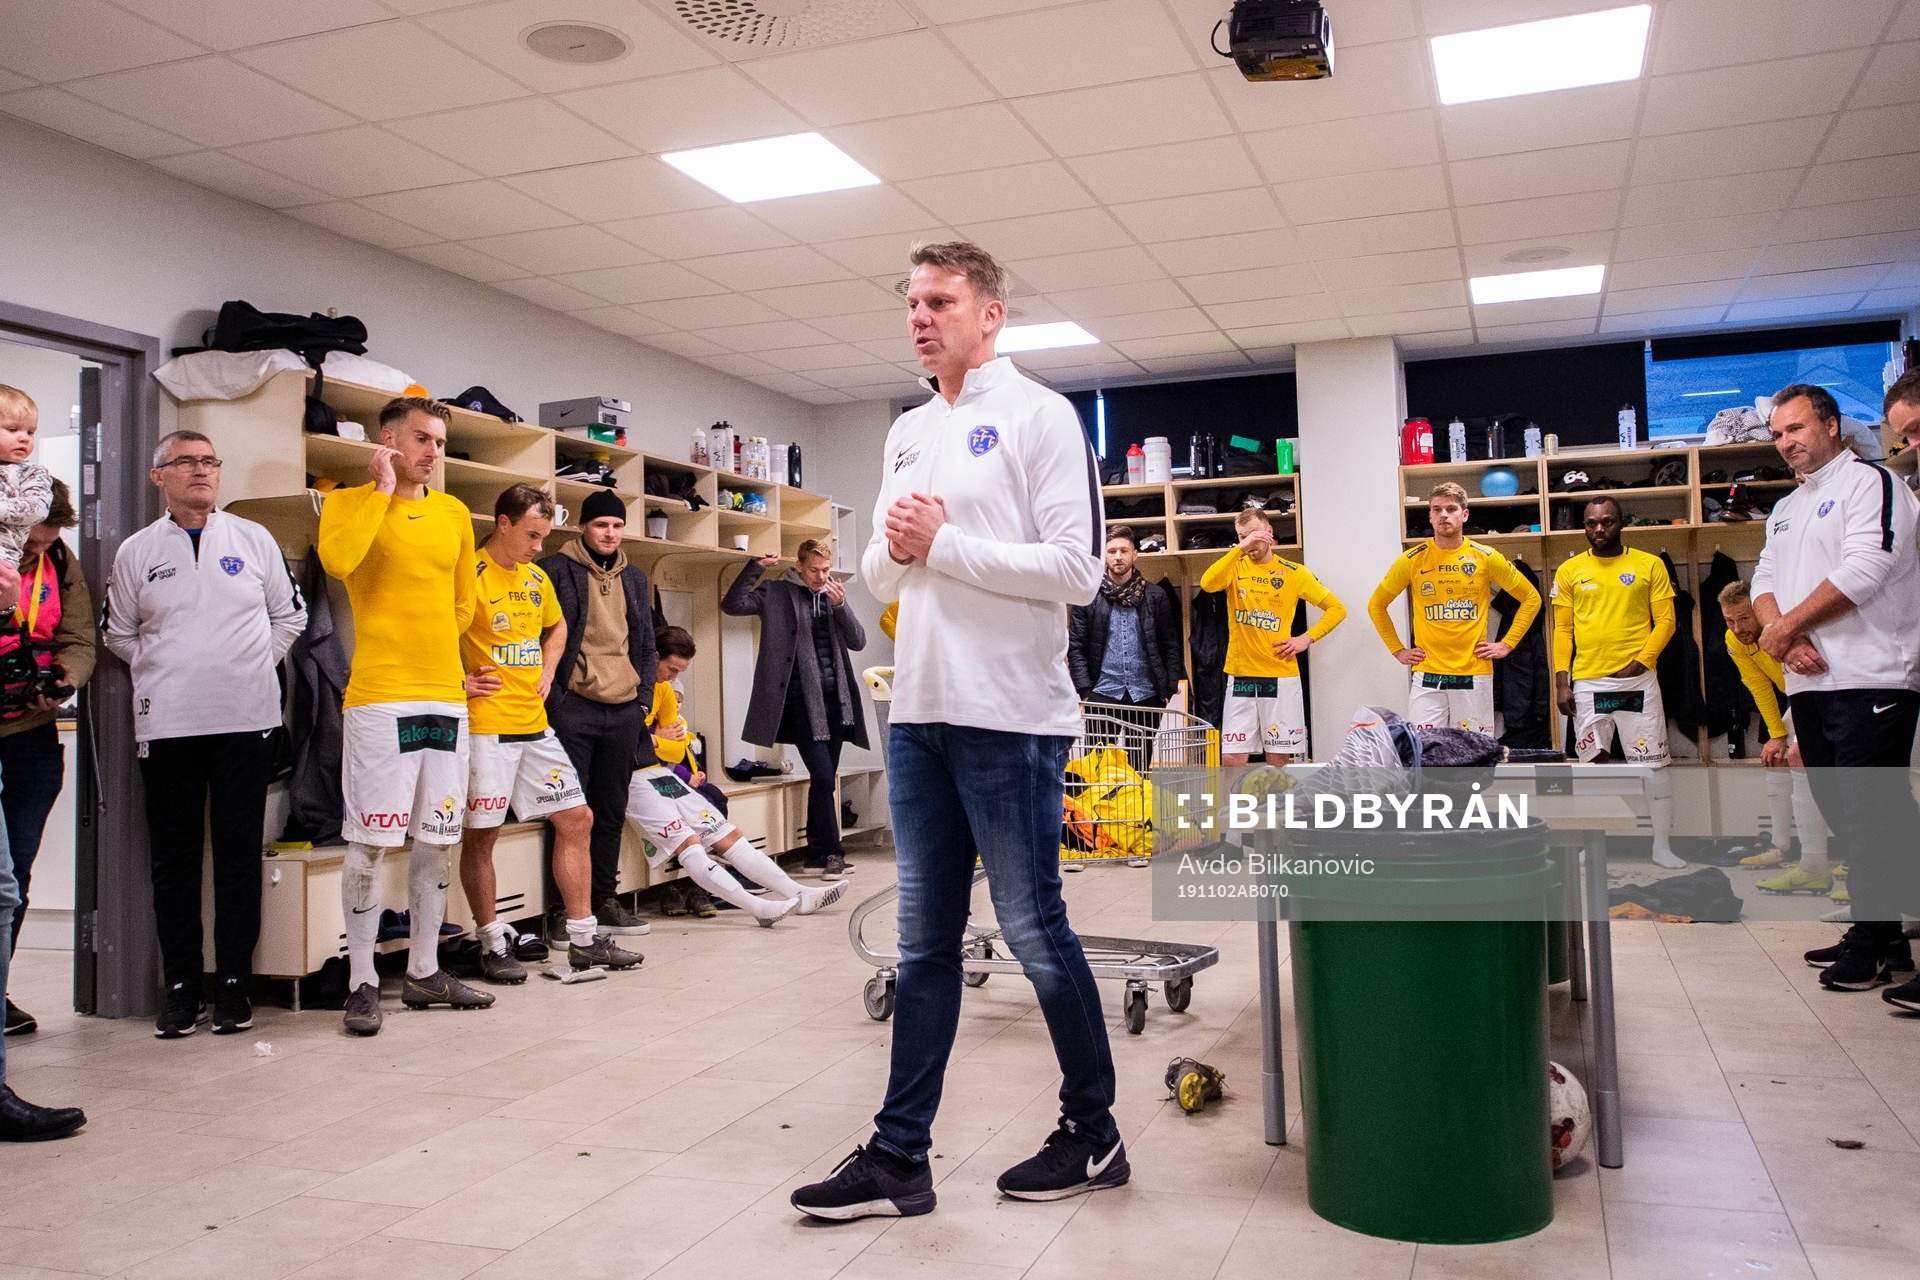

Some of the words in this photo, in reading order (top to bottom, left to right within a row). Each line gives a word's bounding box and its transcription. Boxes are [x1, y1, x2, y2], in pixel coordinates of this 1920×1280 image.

[1563, 470, 1590, 484] 64
[1438, 564, 1460, 573] FBG
[1251, 576, 1270, 585] FBG
[508, 591, 528, 602] FBG
[1235, 609, 1281, 632] Ullared
[1424, 603, 1479, 621] Ullared
[491, 643, 543, 667] Ullare
[138, 698, 151, 716] JB
[400, 723, 442, 744] akea
[136, 741, 150, 759] JB
